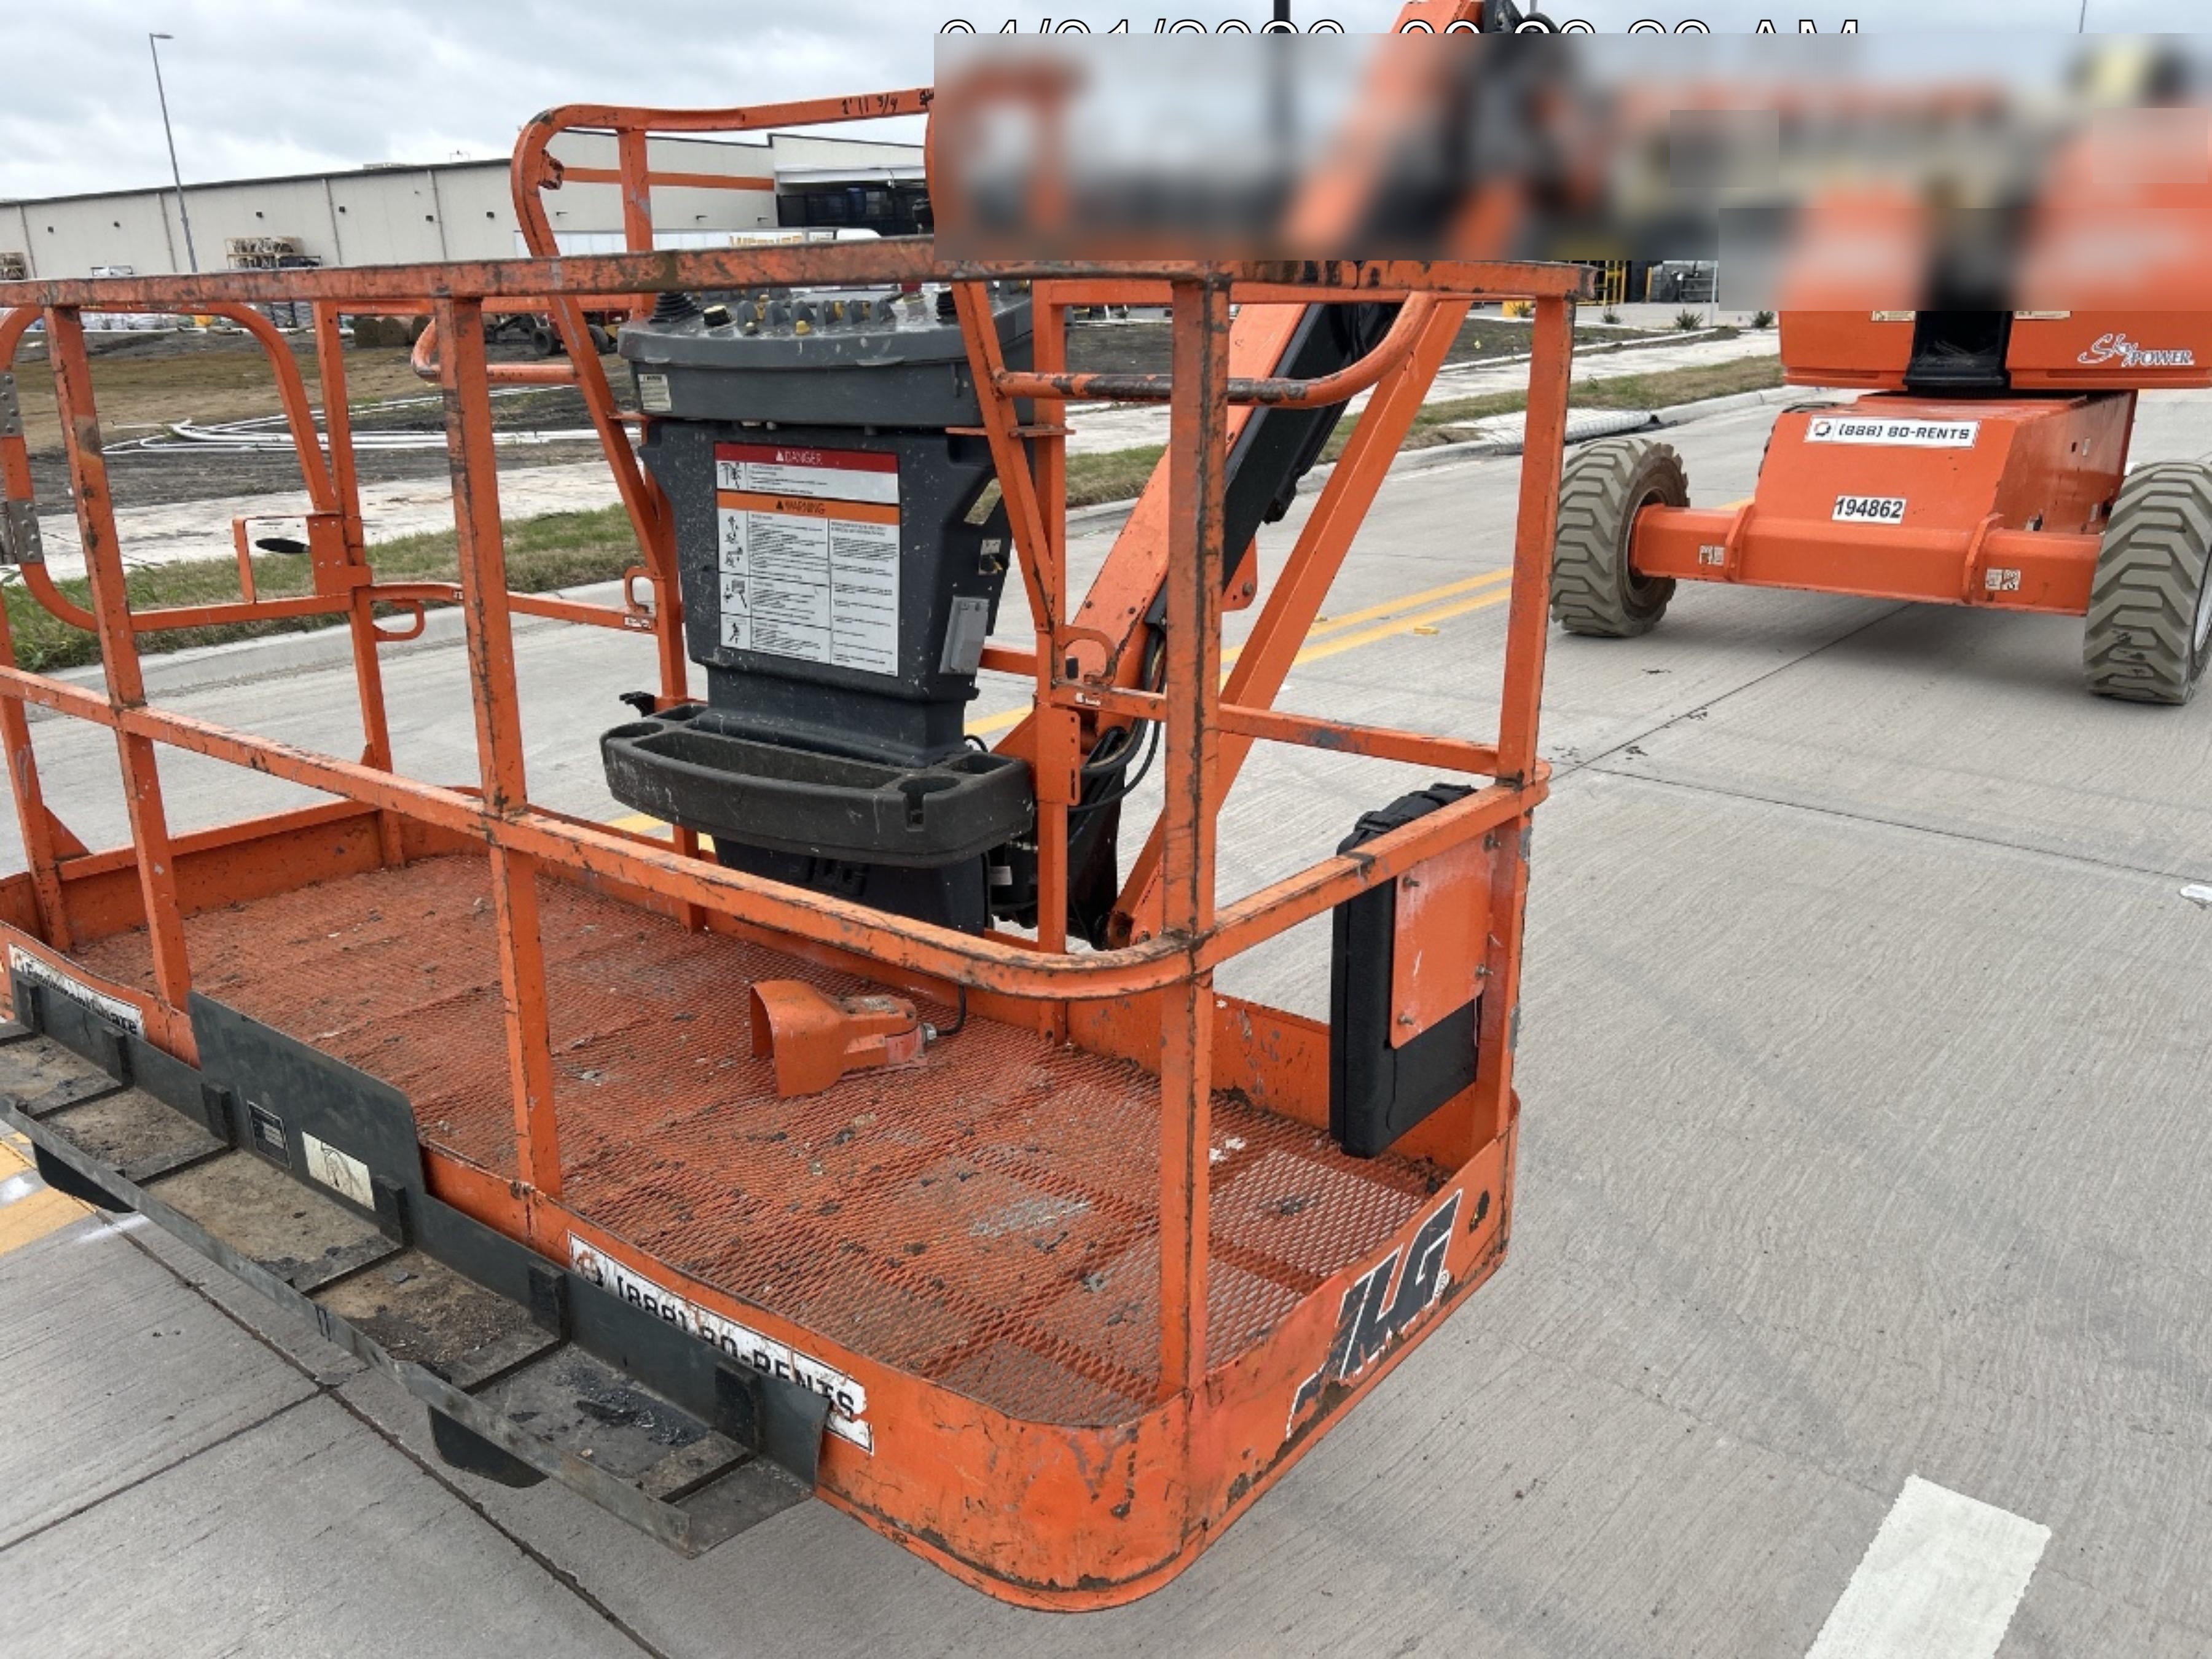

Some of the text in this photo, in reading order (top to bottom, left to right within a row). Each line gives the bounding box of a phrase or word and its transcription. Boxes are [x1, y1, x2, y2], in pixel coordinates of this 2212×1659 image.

[1838, 423, 1970, 440] (888) 80-RENTS
[785, 450, 823, 466] DANGER
[785, 500, 826, 515] WARNING
[1835, 497, 1904, 519] 194862
